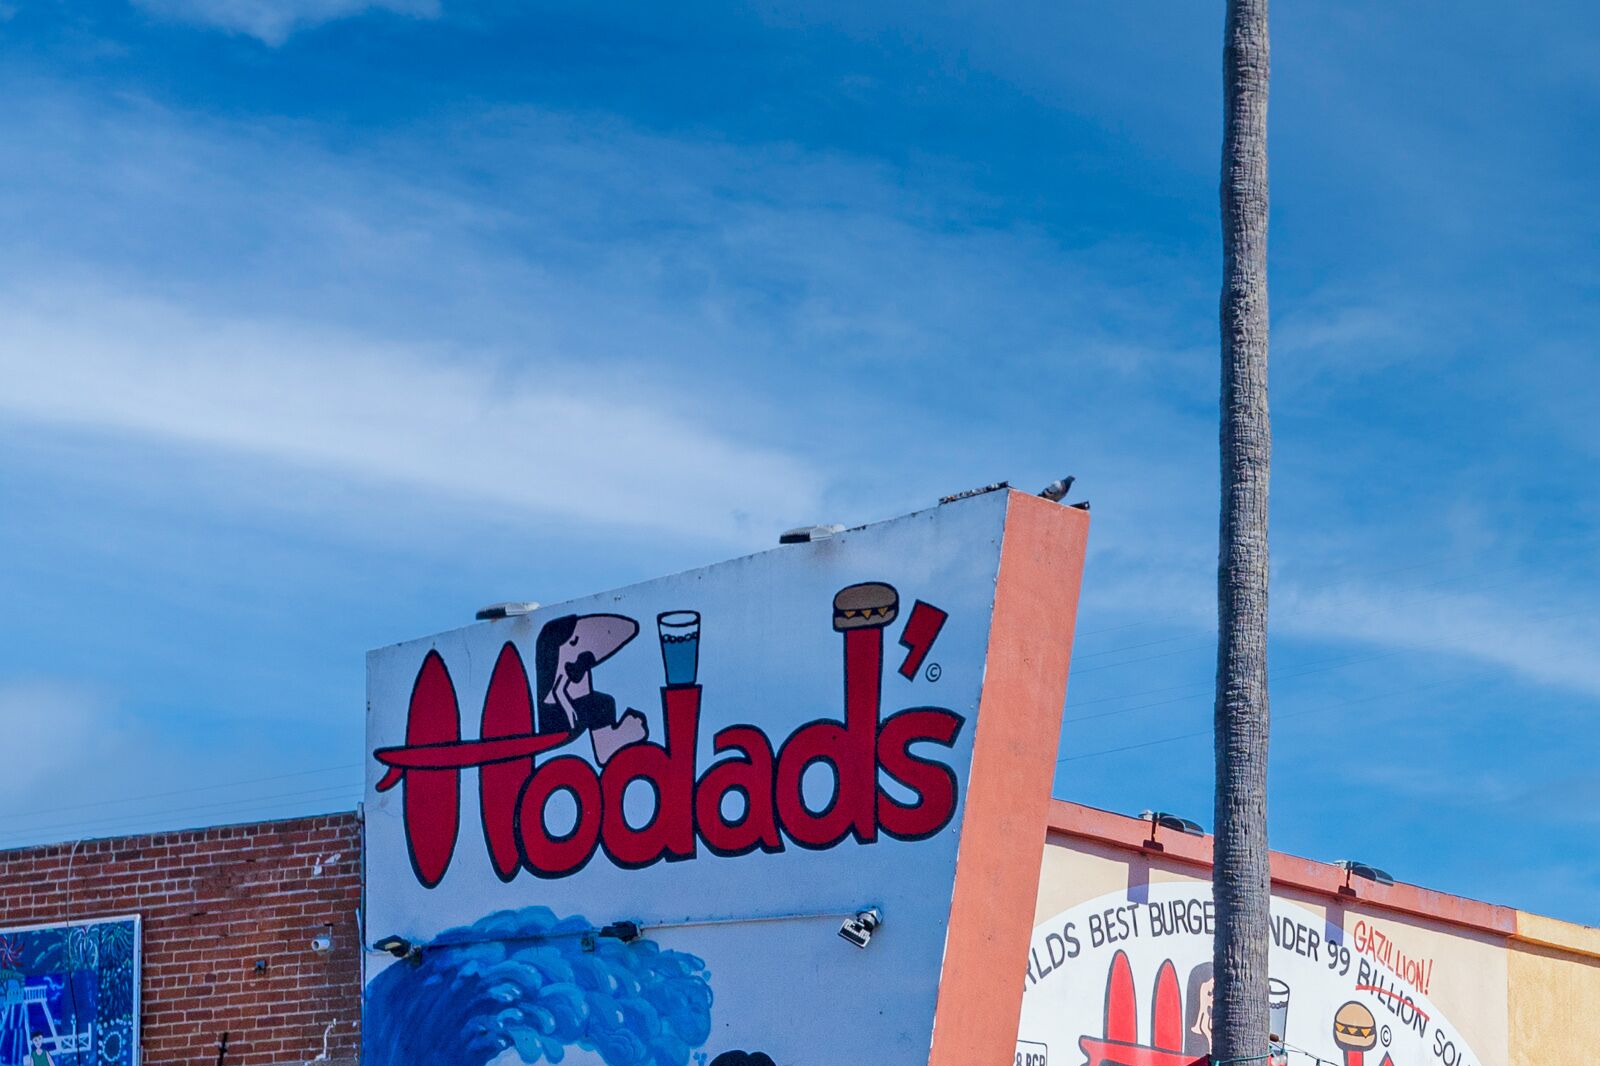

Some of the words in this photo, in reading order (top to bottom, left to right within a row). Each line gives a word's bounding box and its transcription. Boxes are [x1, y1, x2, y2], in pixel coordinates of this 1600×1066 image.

[373, 598, 966, 890] Hodad's
[1089, 903, 1139, 948] BEST
[1327, 939, 1351, 976] 99
[1356, 957, 1429, 1038] BILLION
[1354, 920, 1433, 995] GAZILLION!
